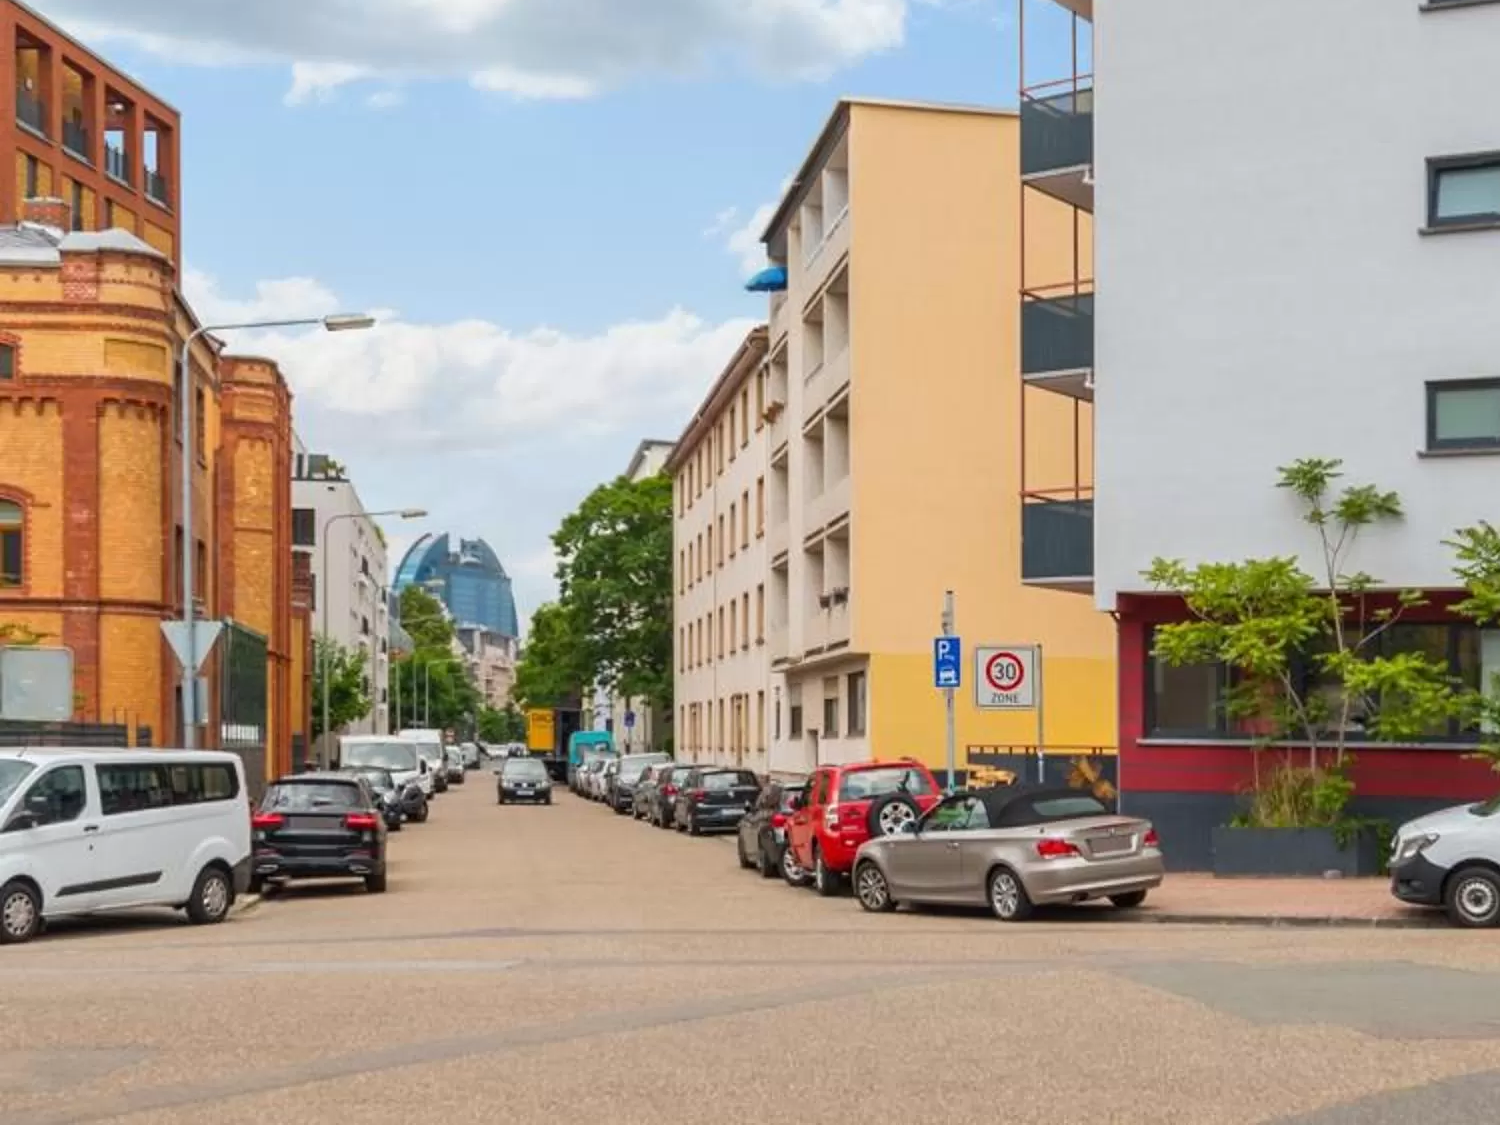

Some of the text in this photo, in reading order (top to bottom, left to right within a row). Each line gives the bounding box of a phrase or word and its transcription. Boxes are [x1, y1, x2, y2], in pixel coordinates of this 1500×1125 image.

[939, 641, 951, 660] P
[994, 662, 1016, 680] 30
[991, 693, 1018, 704] ZONE
